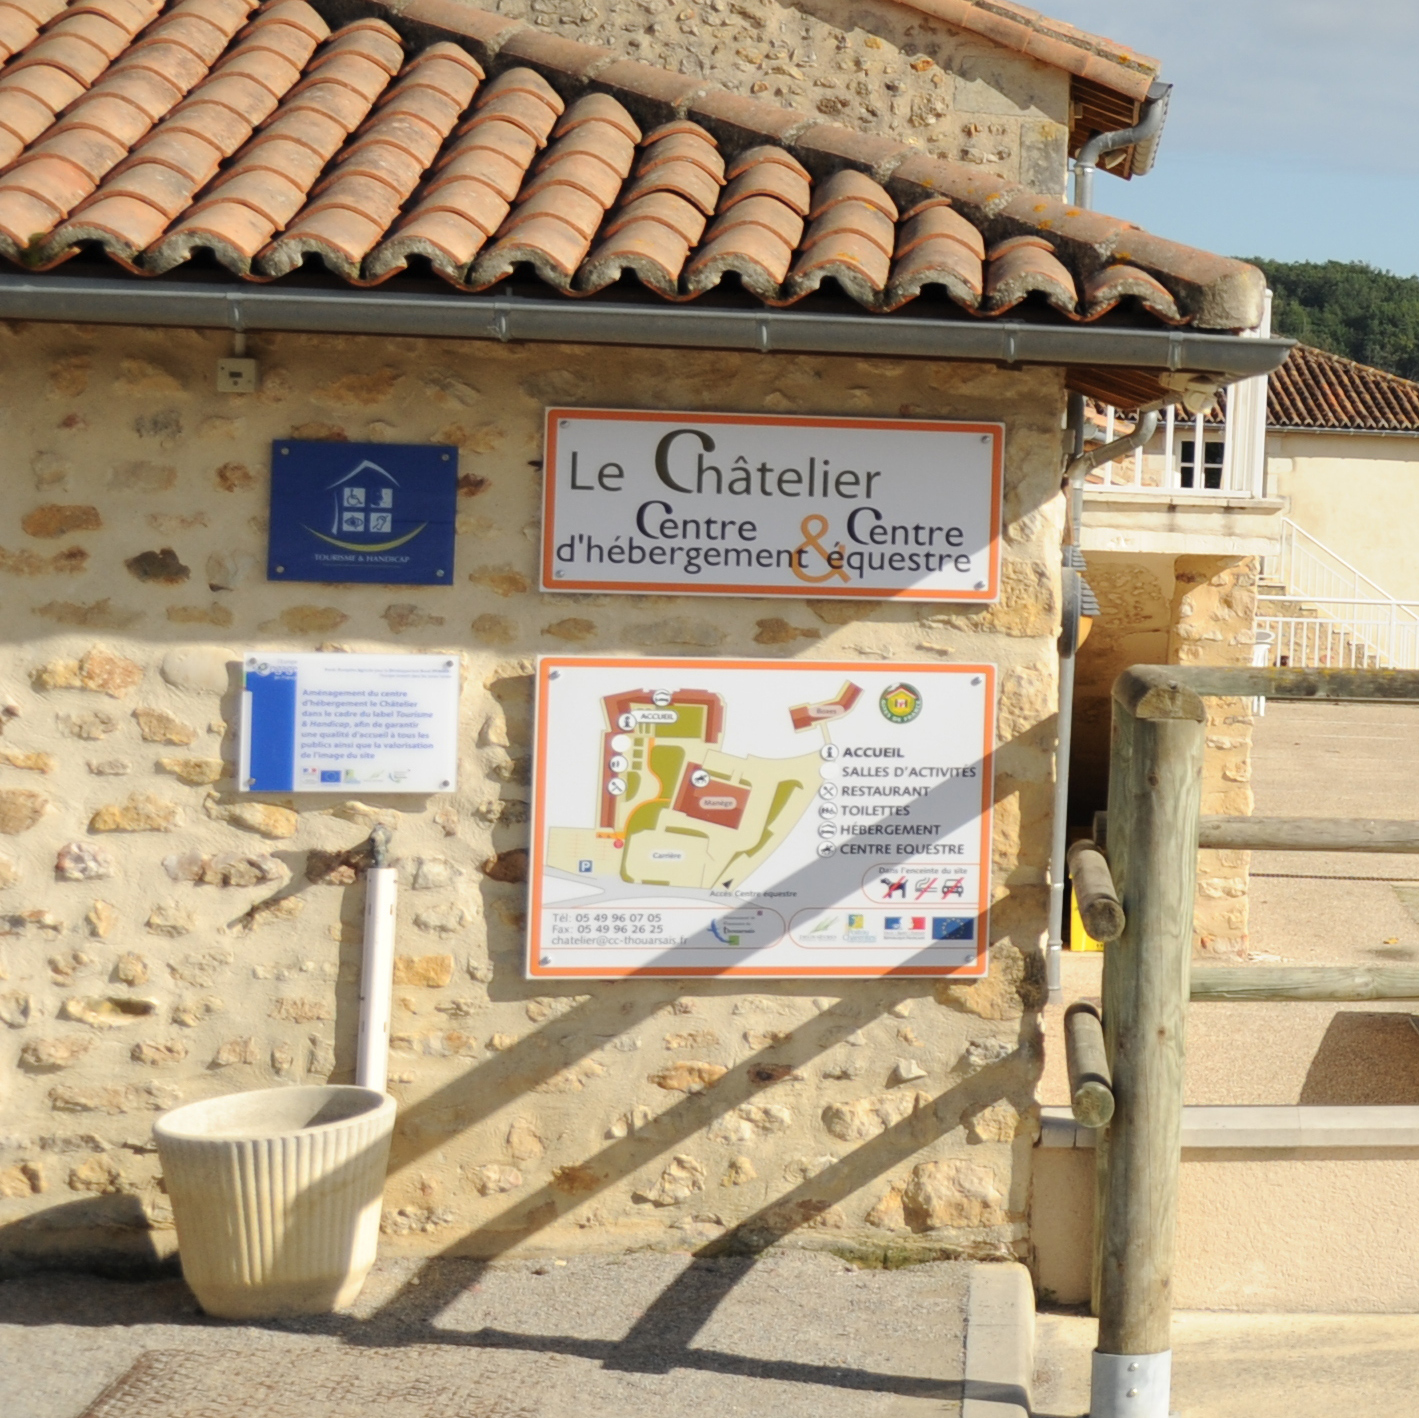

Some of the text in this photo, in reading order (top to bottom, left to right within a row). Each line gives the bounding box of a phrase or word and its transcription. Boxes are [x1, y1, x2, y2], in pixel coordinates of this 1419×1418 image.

[569, 428, 882, 499] Le Châtelier
[636, 499, 757, 541] Centre
[846, 506, 965, 547] Centre
[556, 532, 810, 575] d'hébergement
[789, 513, 852, 584] &
[314, 553, 355, 561] TOURISME
[366, 555, 410, 563] HANDICAP
[826, 541, 972, 579] équestre
[302, 689, 366, 698] Aménagement
[302, 700, 368, 708] d'hébergement
[380, 700, 418, 708] Châtelier
[385, 721, 419, 729] garantir
[320, 731, 350, 739] qualité
[352, 731, 389, 739] d'accueil
[301, 741, 332, 750] publics
[356, 742, 372, 750] que
[313, 752, 345, 760] l'image
[842, 747, 905, 758] ACCUEIL
[842, 764, 977, 778] SALLES D'ACTIVITÉS
[841, 785, 931, 797] RESTAURANT
[703, 798, 734, 807] Manège
[840, 805, 911, 816] TOILETTES
[840, 821, 942, 836] HÉBERGEMENT
[840, 843, 965, 855] CENTRE EQUESTRE
[878, 866, 899, 874] Dans
[901, 866, 939, 874] l'enceinte
[735, 890, 761, 898] Centre
[763, 890, 798, 899] équestre
[552, 913, 662, 923] Tél: 05 49 96 07 05
[552, 924, 664, 934] Fax: 05 49 96 26 25
[551, 935, 688, 946] chatelier@cc-thouarsais.fr
